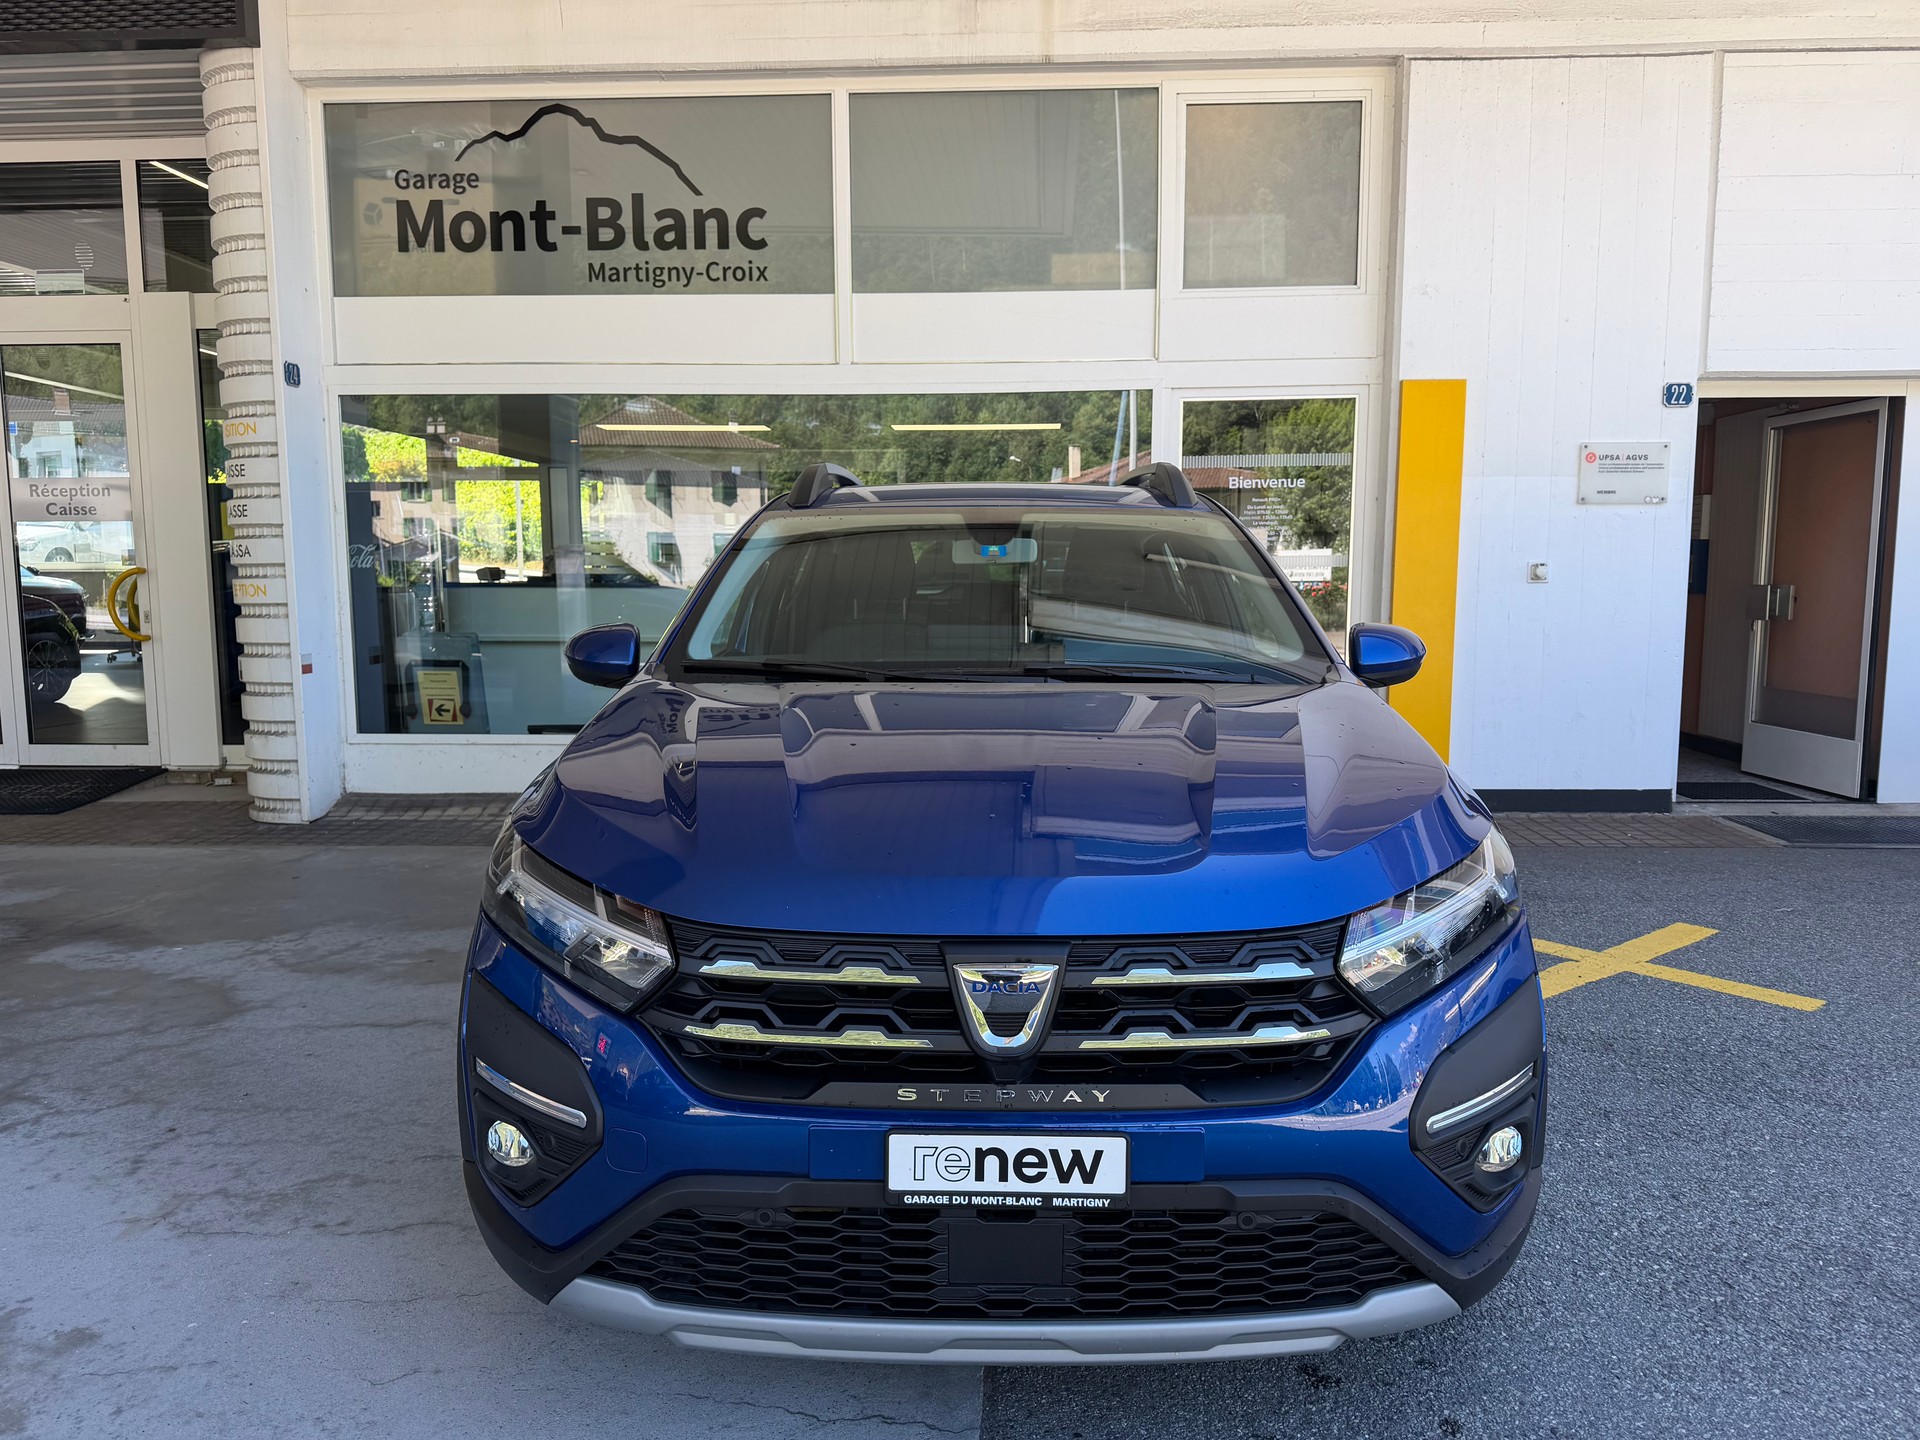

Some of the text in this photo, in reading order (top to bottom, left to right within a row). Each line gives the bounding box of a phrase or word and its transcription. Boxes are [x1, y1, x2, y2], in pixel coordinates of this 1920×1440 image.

[394, 169, 480, 195] Garage
[396, 193, 769, 253] Mont-Blanc
[587, 260, 769, 289] Martigny-Croix
[1671, 385, 1687, 404] 22
[1229, 476, 1306, 489] Bienvenue
[29, 483, 111, 501] Réception
[45, 502, 98, 516] Caisse
[972, 981, 1040, 994] DACIA
[897, 1088, 1110, 1103] STEPWAY
[913, 1146, 1104, 1185] renew
[904, 1195, 1110, 1208] GARAGE DU MONT-BLANC MARTIGNY
